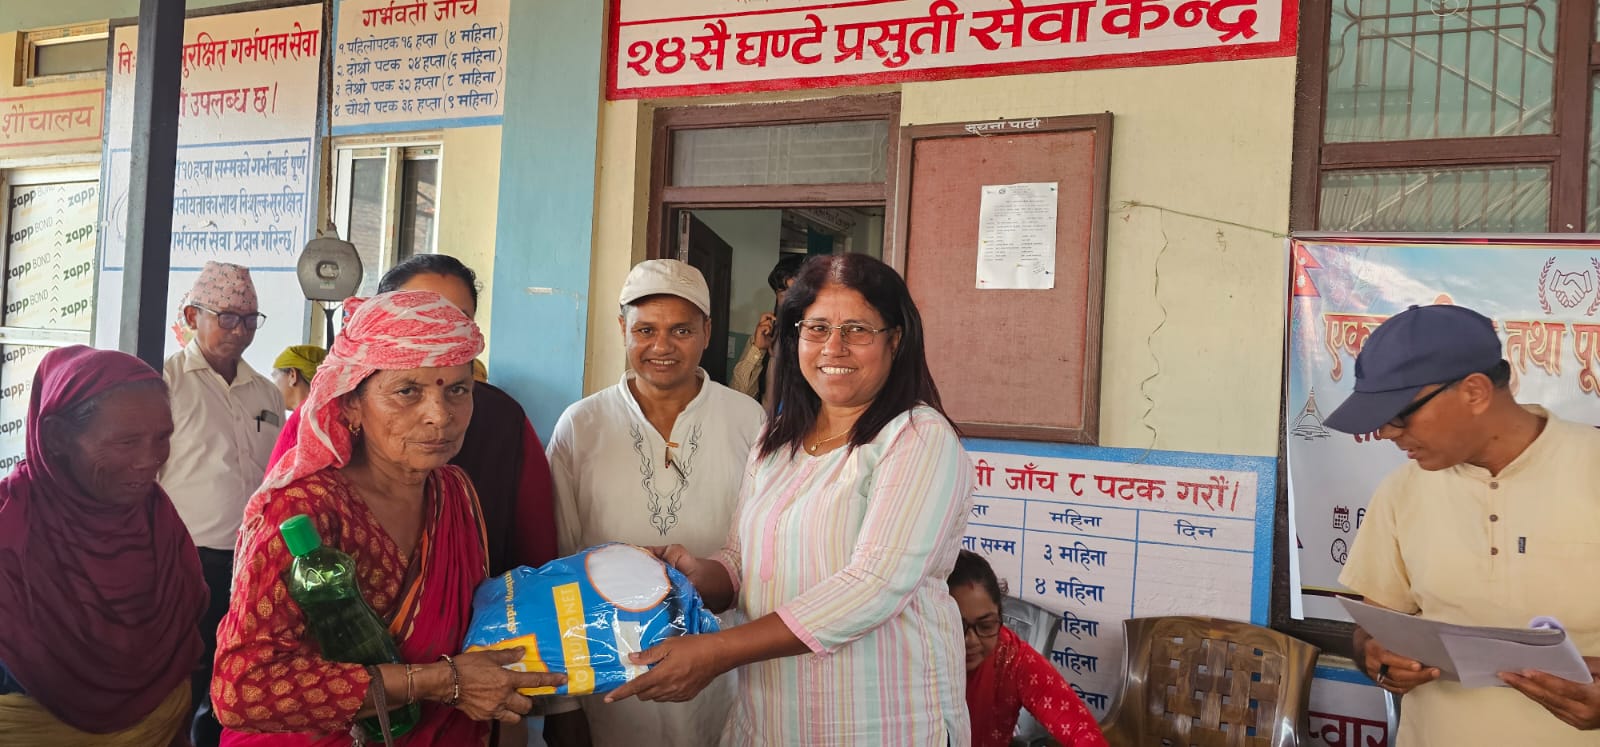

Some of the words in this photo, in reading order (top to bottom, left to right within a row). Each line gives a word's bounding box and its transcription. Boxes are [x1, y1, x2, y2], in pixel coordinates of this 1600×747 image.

[290, 21, 320, 62] सेवा
[736, 13, 827, 68] घण्टे
[374, 59, 402, 73] पटक
[371, 80, 395, 92] पटक
[191, 87, 250, 118] उपलब्ध
[374, 100, 399, 113] पटक
[67, 187, 95, 207] zapp
[65, 224, 93, 244] zapp
[63, 261, 91, 280] zapp
[61, 298, 88, 317] zapp
[1005, 462, 1059, 493] जाँच
[1068, 473, 1085, 497] ८
[1094, 475, 1166, 501] पटक
[1049, 509, 1102, 531] महिना
[1174, 519, 1216, 540] दिन
[980, 536, 1016, 555] सम्म
[1043, 544, 1054, 565] ३
[1059, 541, 1107, 571] महिना
[1035, 577, 1046, 595] ४
[1055, 577, 1105, 605] महिना
[1051, 647, 1098, 675] महिना
